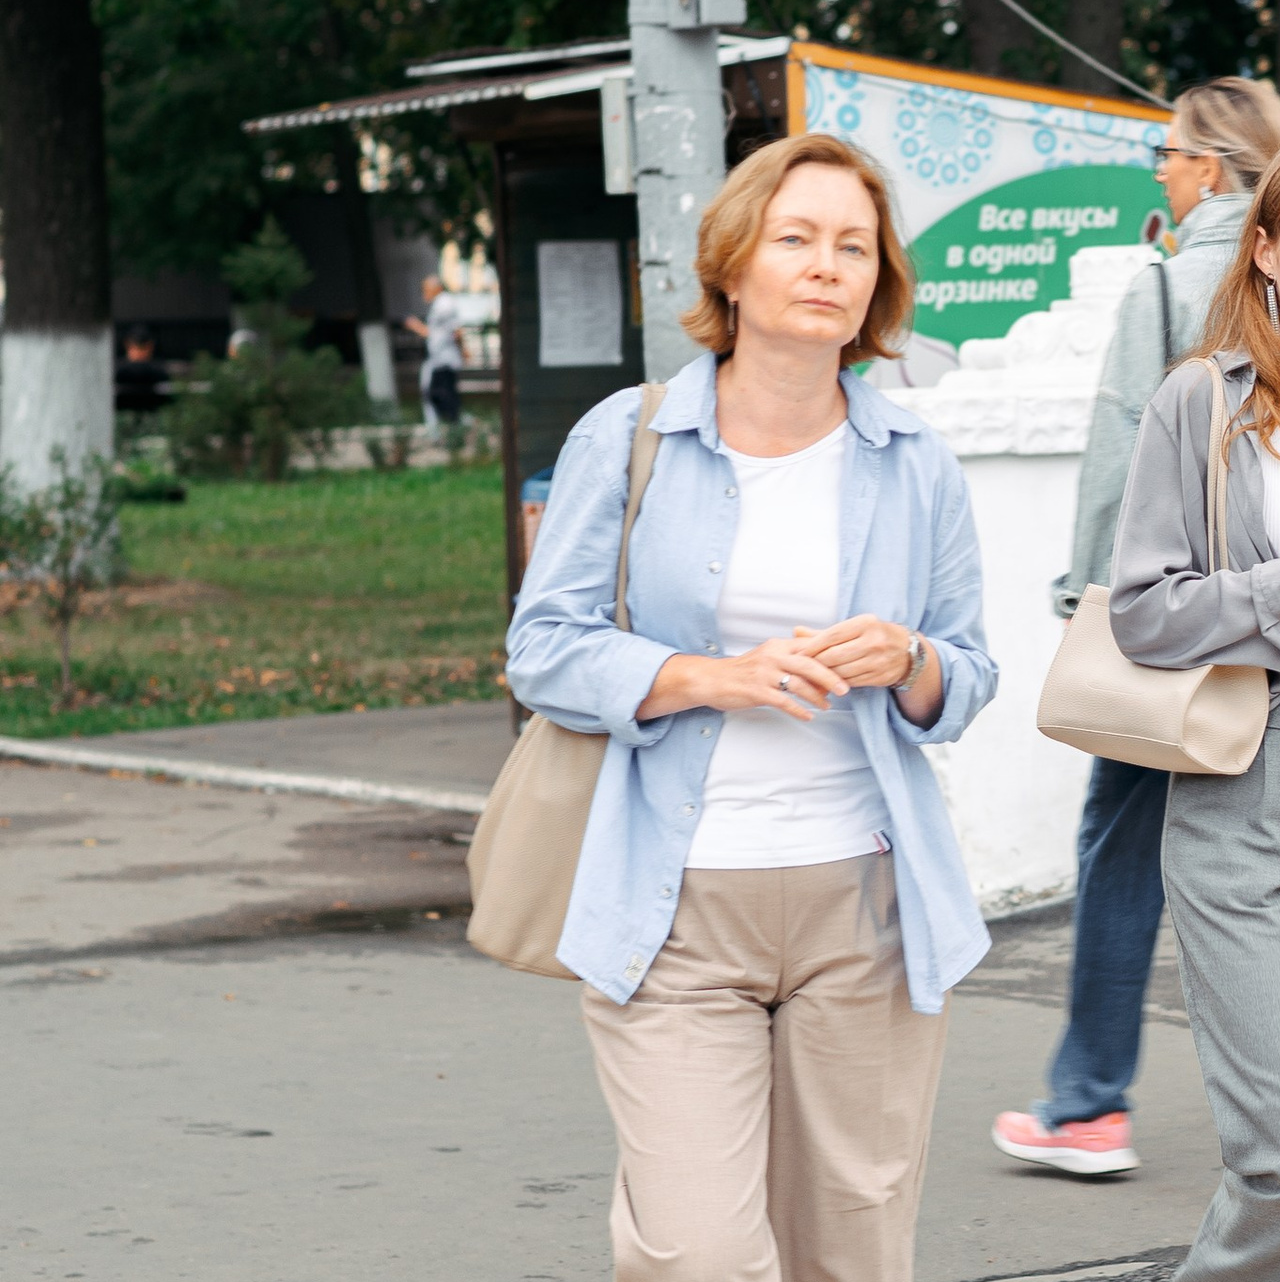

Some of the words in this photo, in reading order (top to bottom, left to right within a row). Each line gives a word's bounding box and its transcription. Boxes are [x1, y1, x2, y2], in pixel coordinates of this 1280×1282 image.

[978, 204, 1026, 231] Все
[1031, 206, 1119, 237] вкусы
[946, 245, 965, 267] в
[968, 237, 1057, 274] одной
[915, 278, 1038, 312] орзинке
